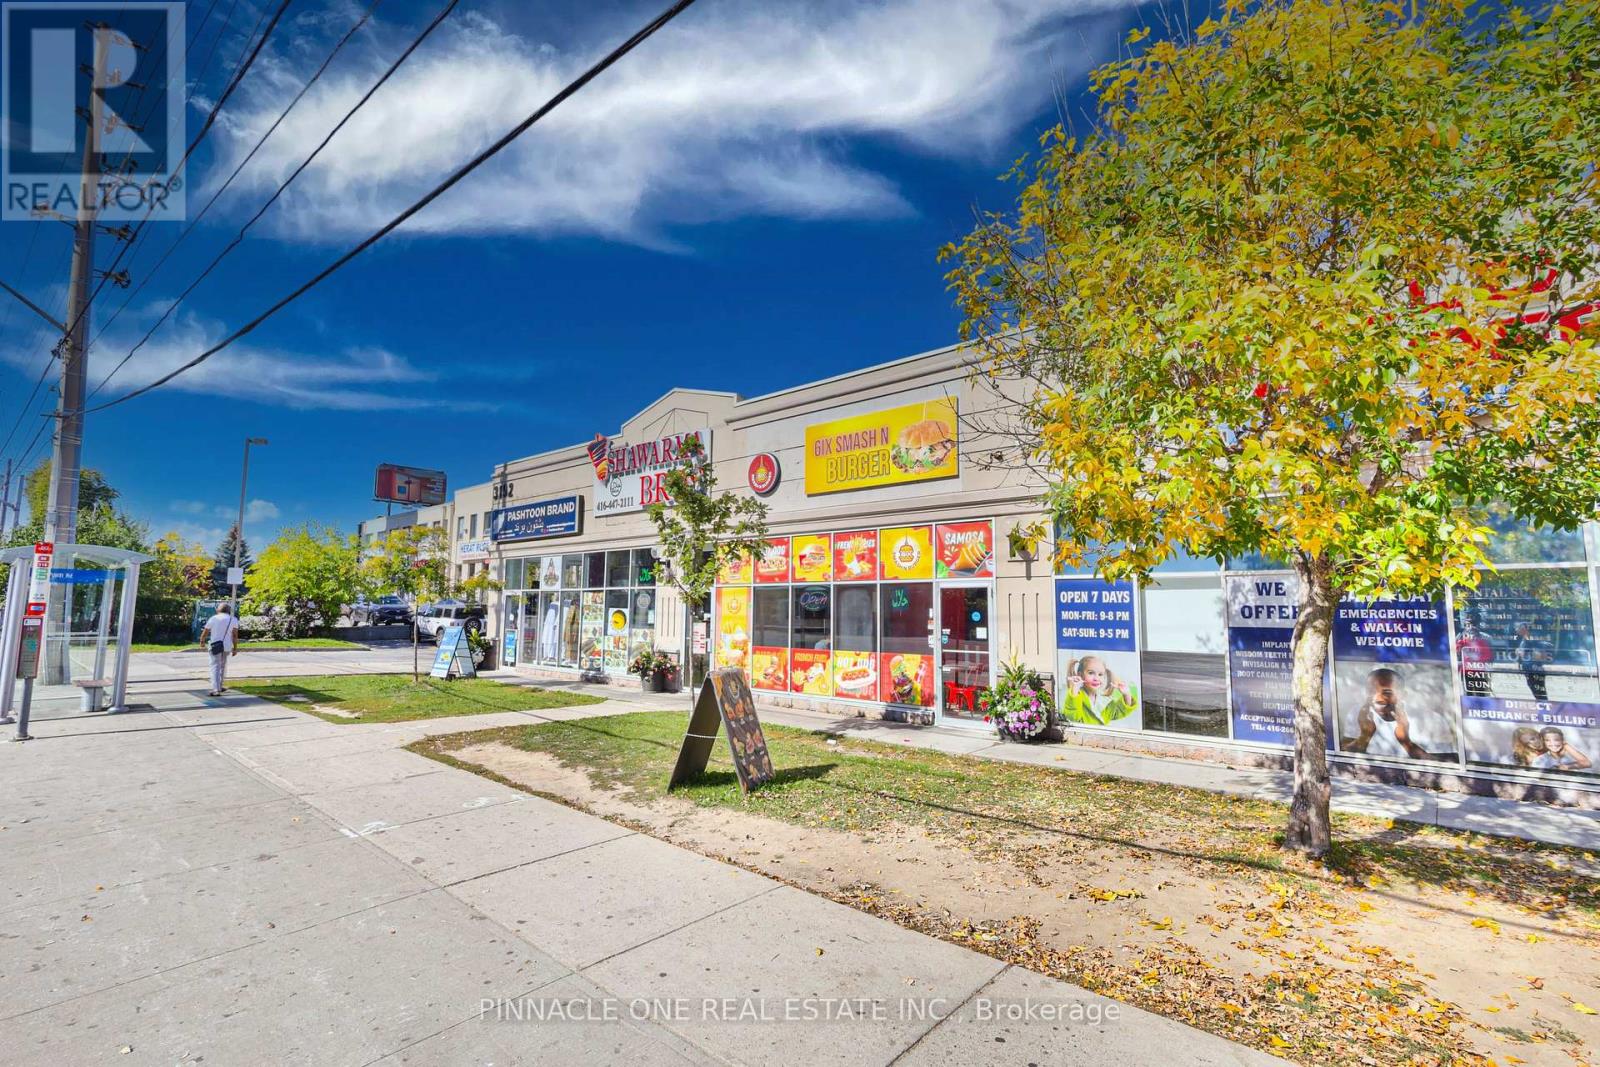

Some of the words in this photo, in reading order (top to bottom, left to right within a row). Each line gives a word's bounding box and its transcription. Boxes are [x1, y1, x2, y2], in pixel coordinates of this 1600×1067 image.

[836, 429, 876, 453] SMASH
[880, 427, 889, 446] N
[826, 449, 890, 483] BURGER
[507, 507, 545, 521] PASHTOON
[547, 502, 574, 515] BRAND
[944, 531, 984, 545] SAMOSA
[1255, 582, 1287, 597] WE
[800, 591, 828, 605] Open
[1060, 591, 1088, 603] OPEN
[1091, 591, 1098, 603] 7
[1102, 591, 1130, 603] DAYS
[1061, 611, 1097, 621] MON-FRI:
[1099, 611, 1114, 621] 9-8
[1116, 611, 1129, 621] PM
[1340, 609, 1437, 619] EMERGENCIES
[1062, 627, 1097, 638] SAT-SUN:
[1099, 628, 1113, 638] 9-5
[1115, 629, 1129, 639] PM
[1350, 622, 1360, 632] &
[1363, 622, 1422, 633] WALK-IN
[1355, 636, 1424, 647] WELCOME
[1242, 661, 1279, 669] INVISALIGN
[1237, 670, 1255, 678] ROOT
[1256, 671, 1279, 680] CANAL
[1505, 700, 1552, 711] DIRECT
[1240, 714, 1274, 723] ACCEPTING
[1469, 709, 1539, 722] INSURANCE
[1543, 714, 1596, 726] BILLING
[1251, 723, 1265, 731] TEL:
